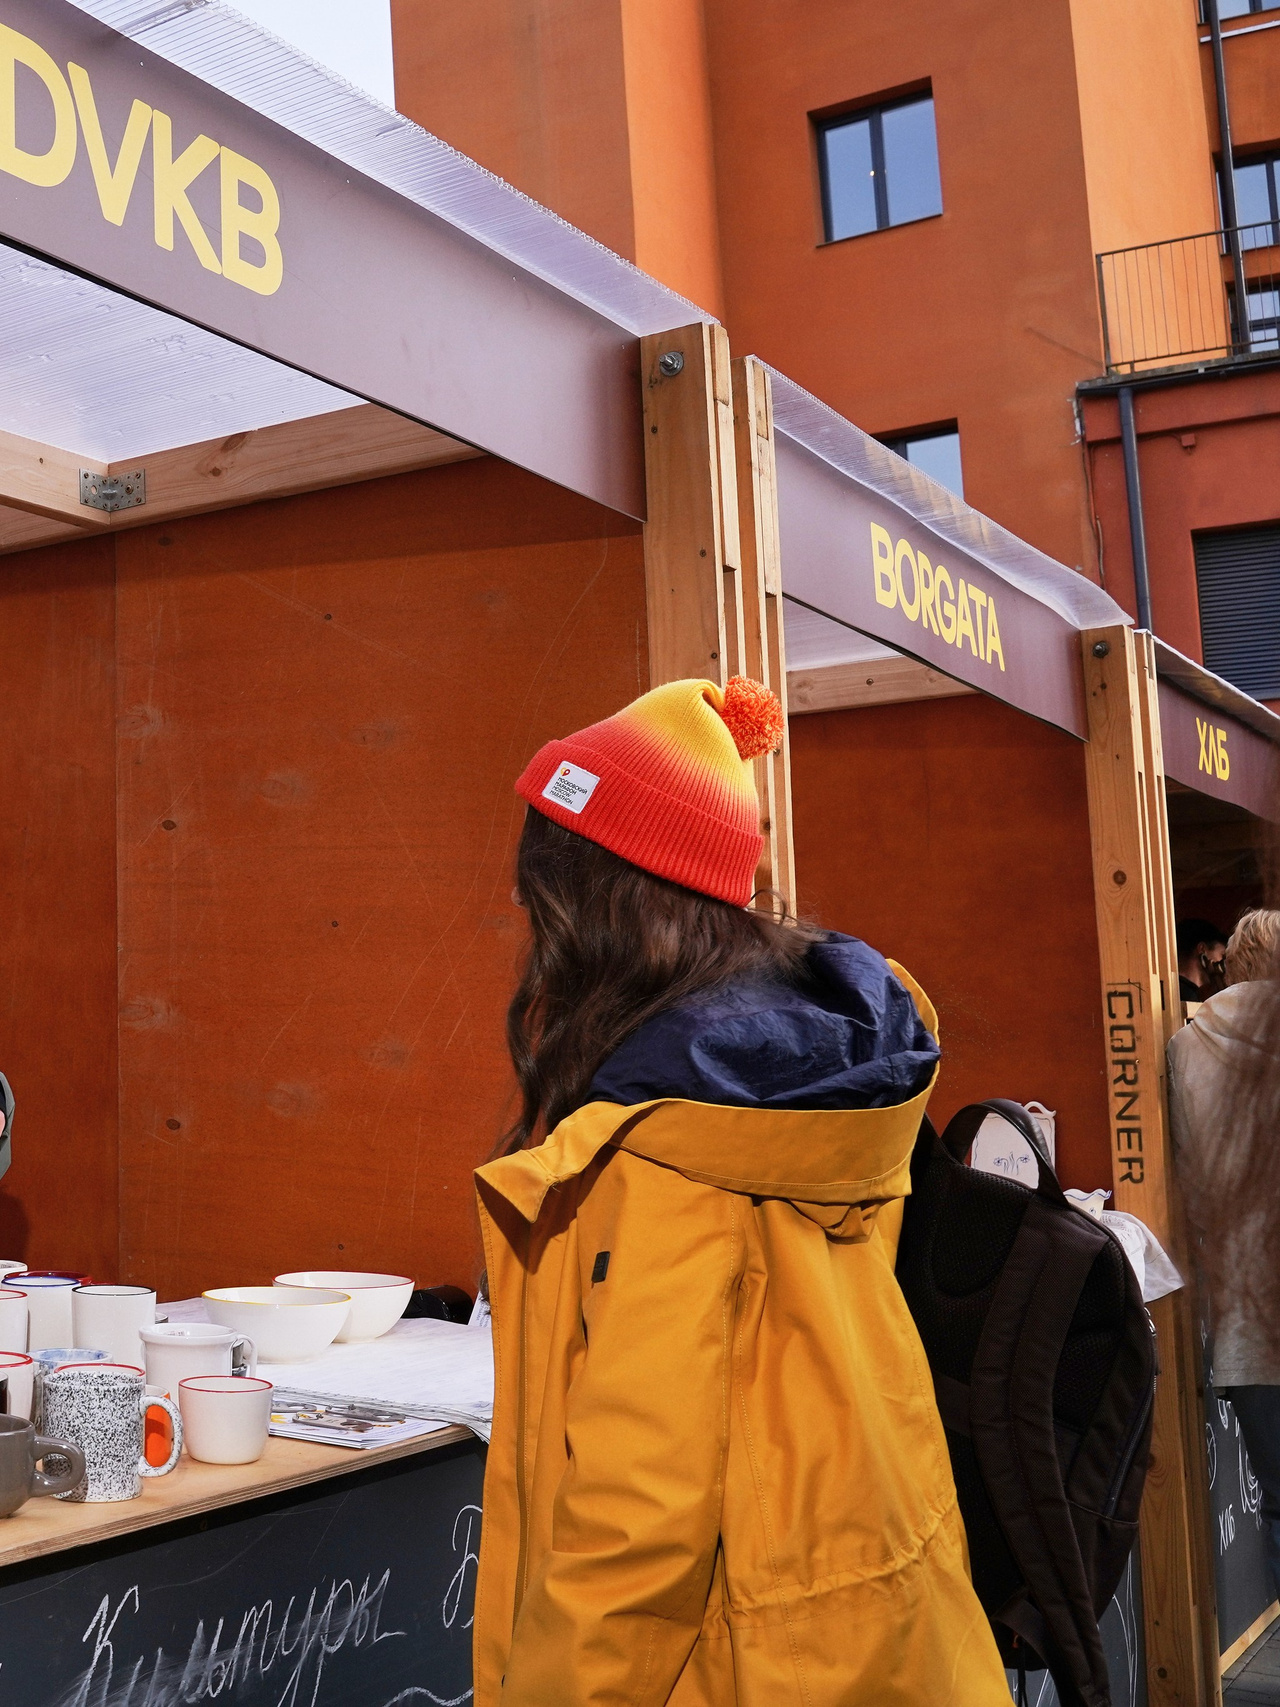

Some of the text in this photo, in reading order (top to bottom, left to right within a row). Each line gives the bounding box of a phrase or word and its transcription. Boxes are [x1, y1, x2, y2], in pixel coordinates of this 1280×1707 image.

[870, 521, 1006, 672] BORGATA
[1195, 717, 1230, 781] ХЛБ
[1107, 990, 1144, 1184] CORNER
